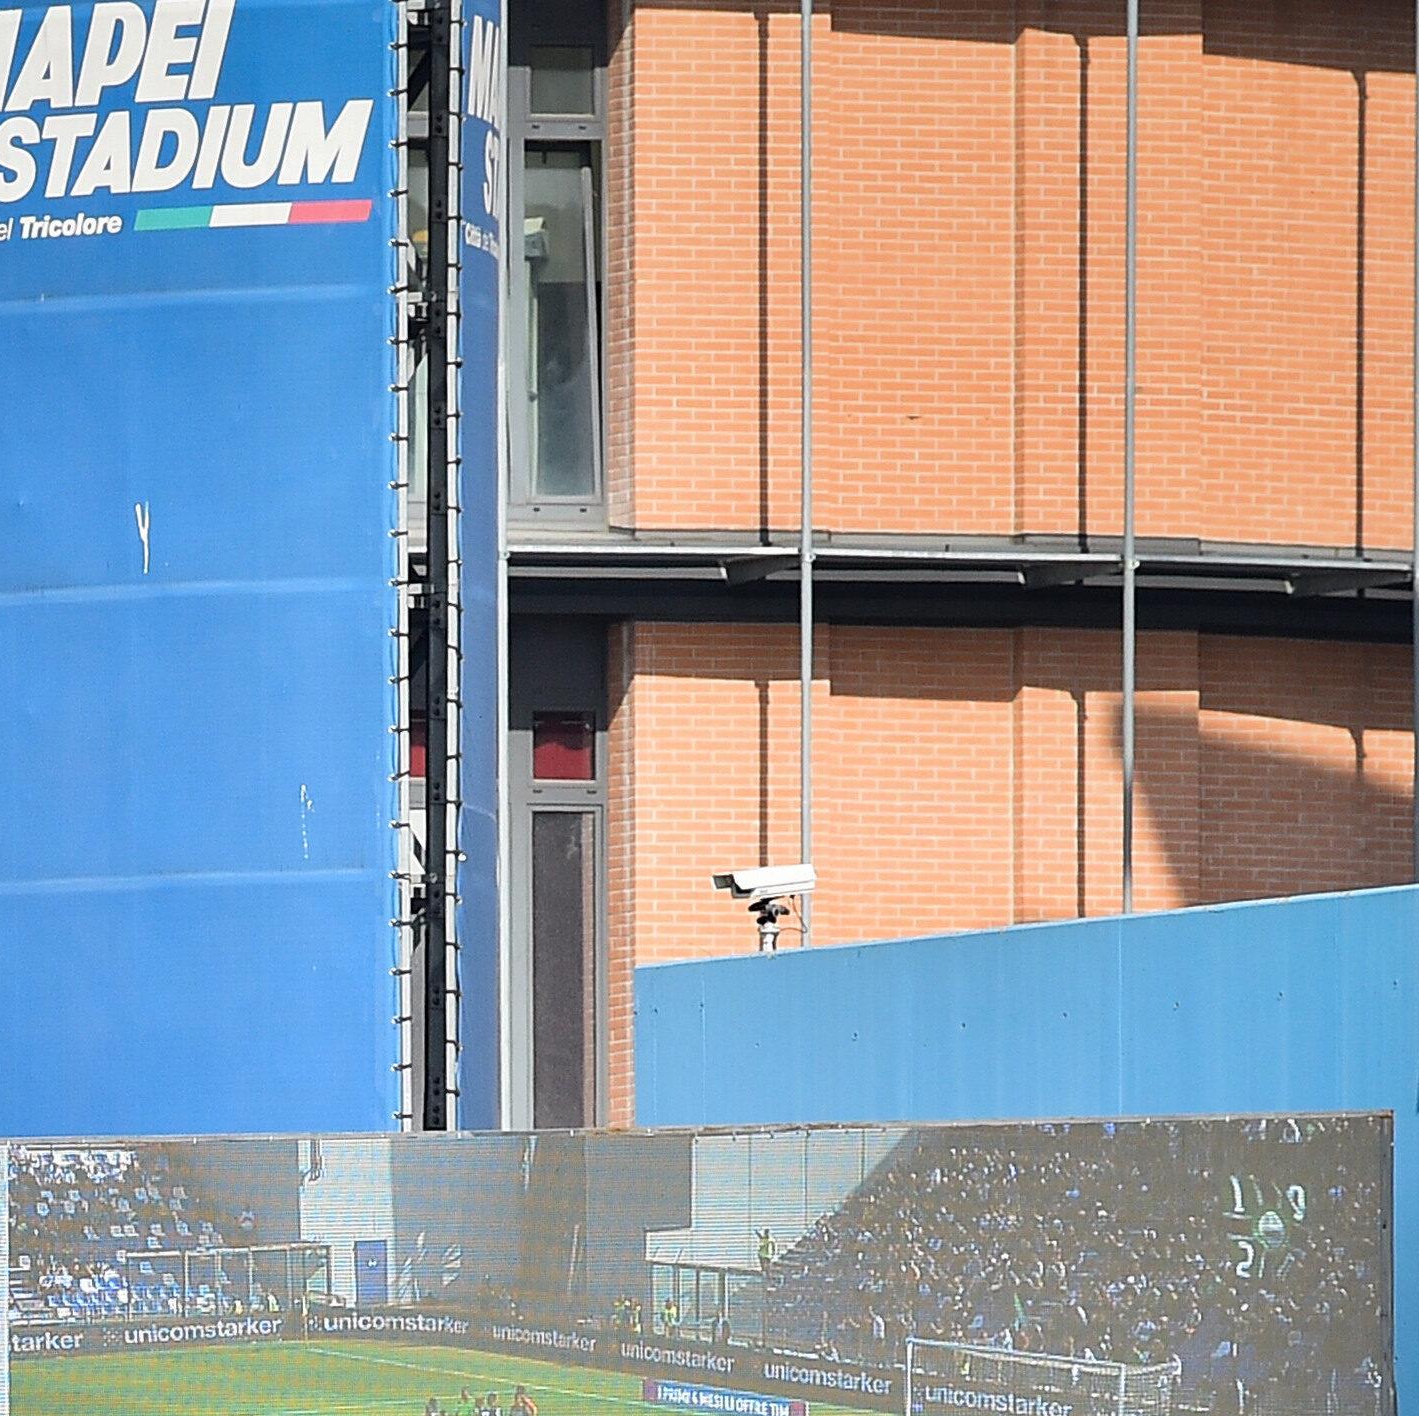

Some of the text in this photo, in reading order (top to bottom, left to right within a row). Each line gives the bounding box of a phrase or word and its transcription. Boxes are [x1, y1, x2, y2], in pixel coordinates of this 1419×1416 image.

[20, 212, 123, 239] Tricolore
[123, 1316, 282, 1344] unicomstarker
[323, 1311, 469, 1335] unicomstarker
[492, 1324, 597, 1352] unicomstarker
[620, 1341, 736, 1372] unicomstarker
[763, 1362, 893, 1394] unicomstarker
